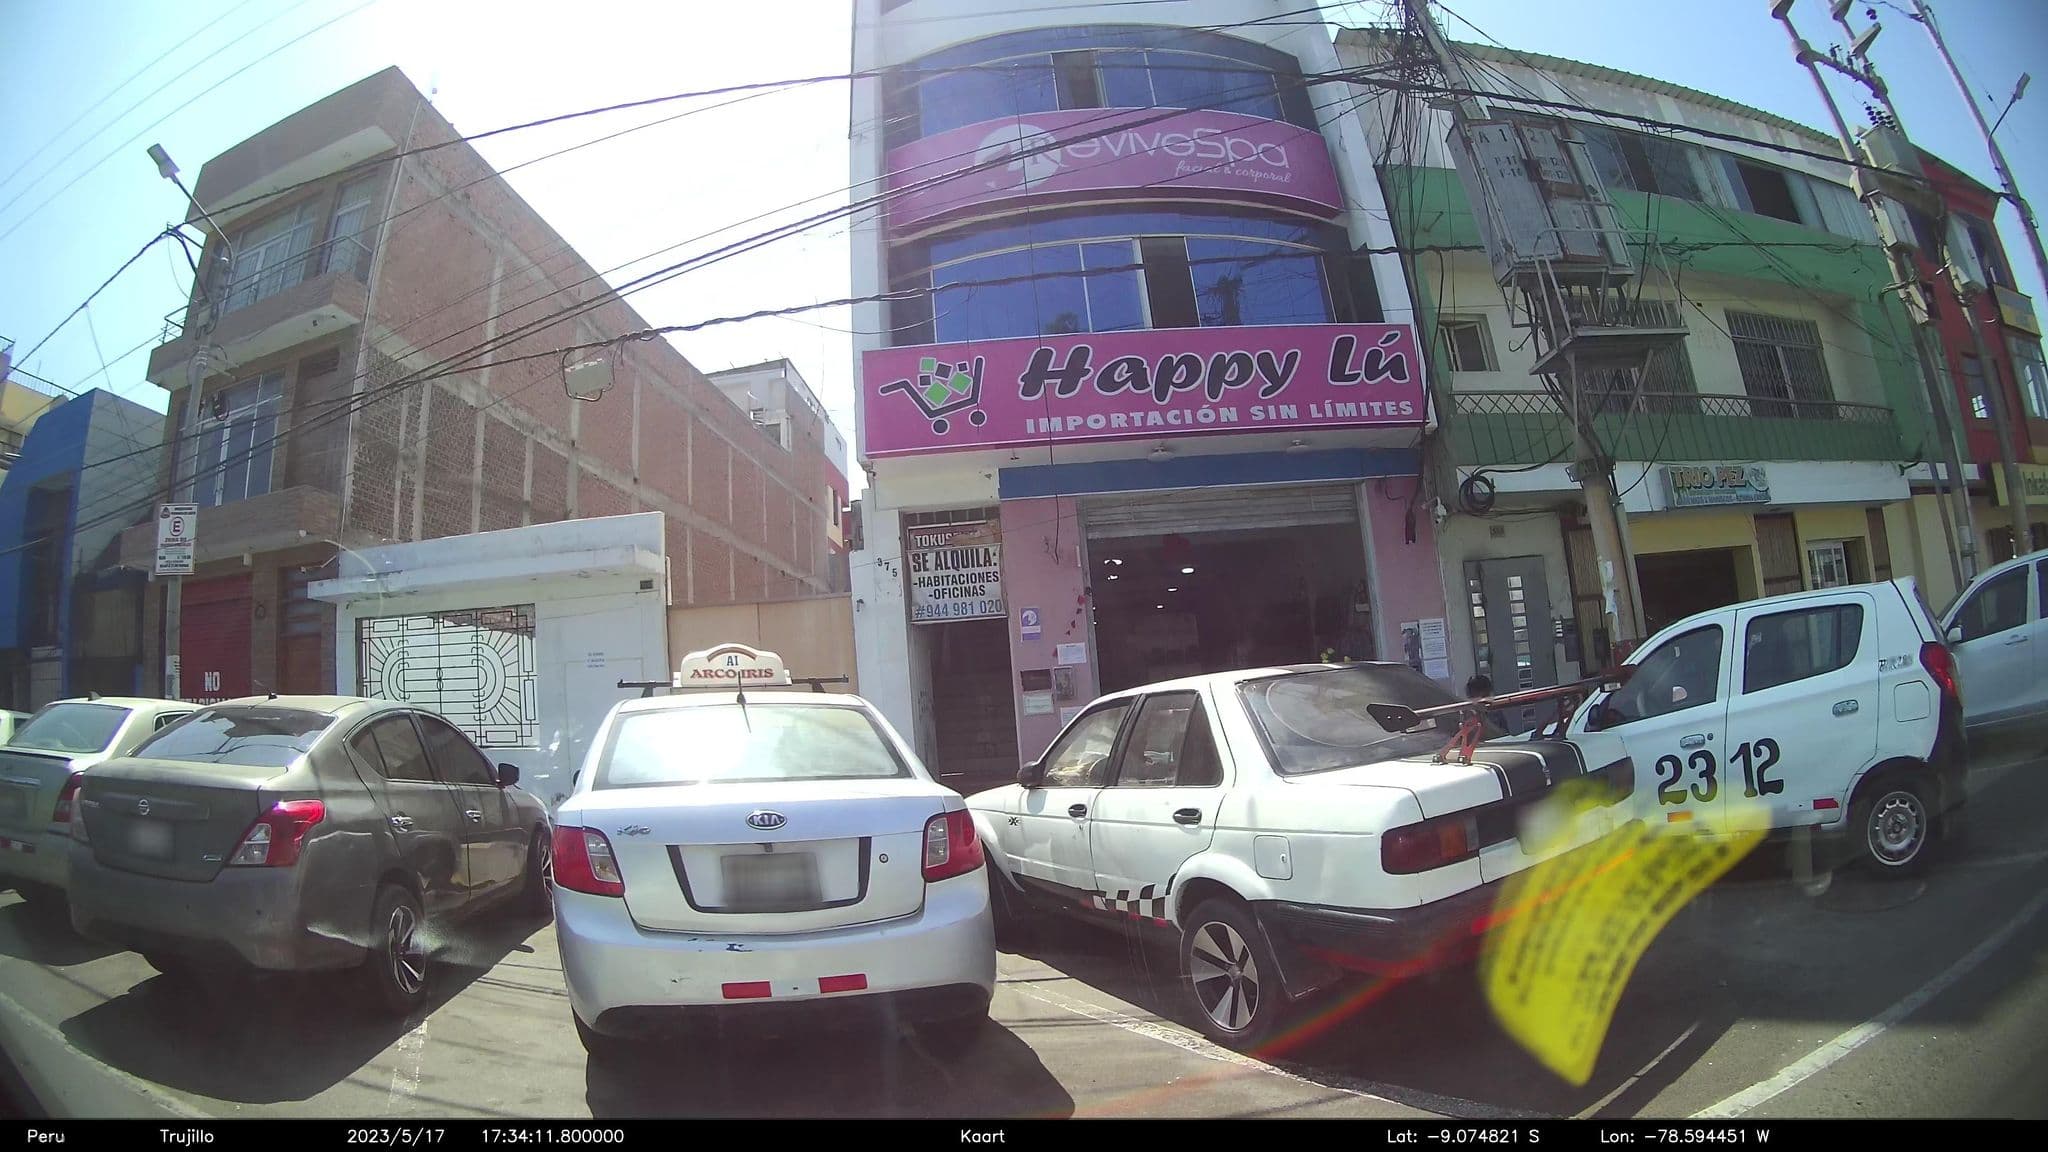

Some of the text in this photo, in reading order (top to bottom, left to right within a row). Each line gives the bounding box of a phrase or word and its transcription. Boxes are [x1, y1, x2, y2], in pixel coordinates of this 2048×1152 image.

[1235, 165, 1292, 183] corporal
[1019, 330, 1411, 404] Happy Lú
[1025, 399, 1414, 434] IMPORTACIÓN SIN LÍMITES
[172, 521, 181, 533] E
[912, 548, 997, 573] SE ALQUILA:
[913, 571, 1000, 588] -HABITACIONES
[928, 585, 986, 600] -OFICINAS
[915, 599, 1001, 618] #944 981 020
[204, 671, 220, 692] NO
[690, 668, 774, 679] ARCO IRIS
